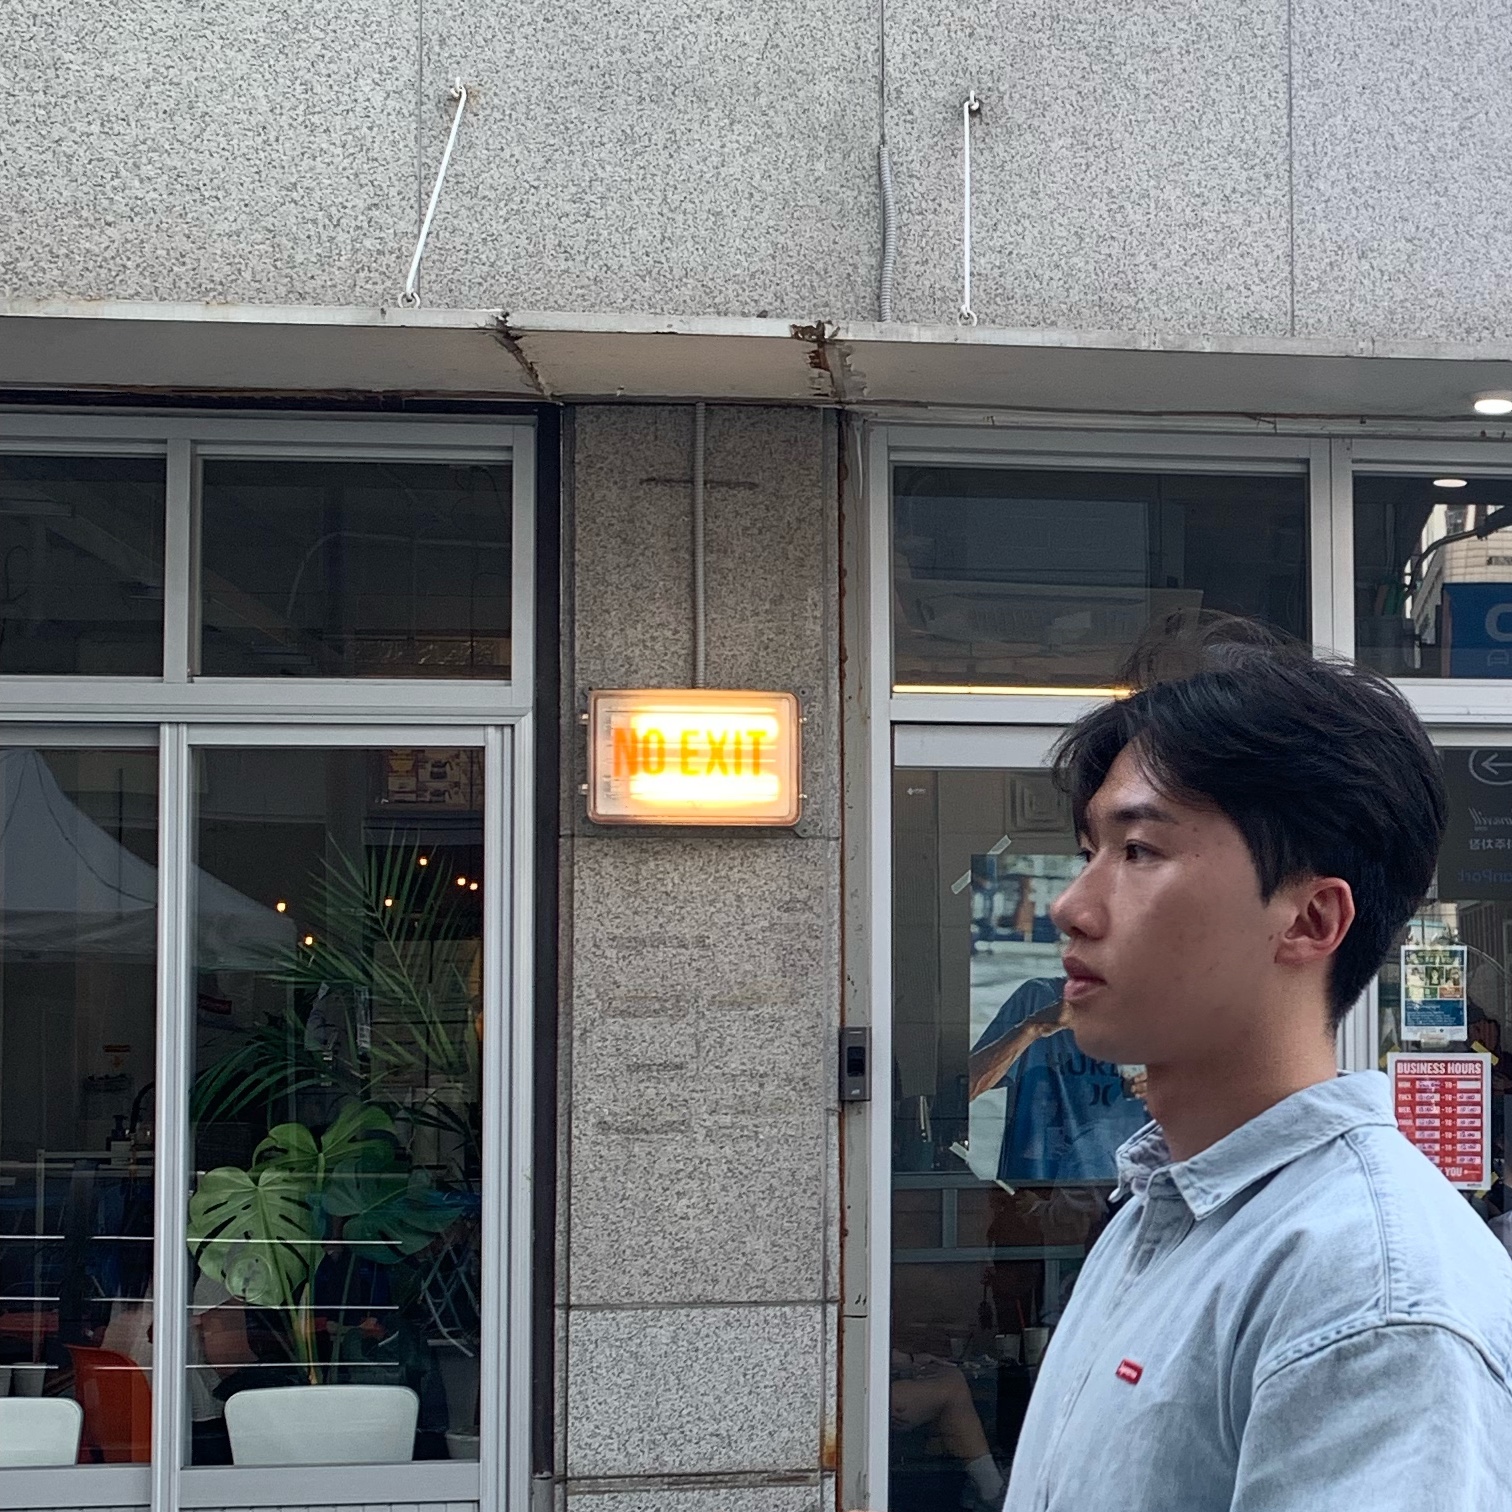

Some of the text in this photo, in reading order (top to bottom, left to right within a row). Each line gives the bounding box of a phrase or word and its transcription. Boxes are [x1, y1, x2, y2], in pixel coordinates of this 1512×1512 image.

[613, 727, 768, 778] NO EXIT
[1396, 1062, 1482, 1075] BUSINESS HOURS
